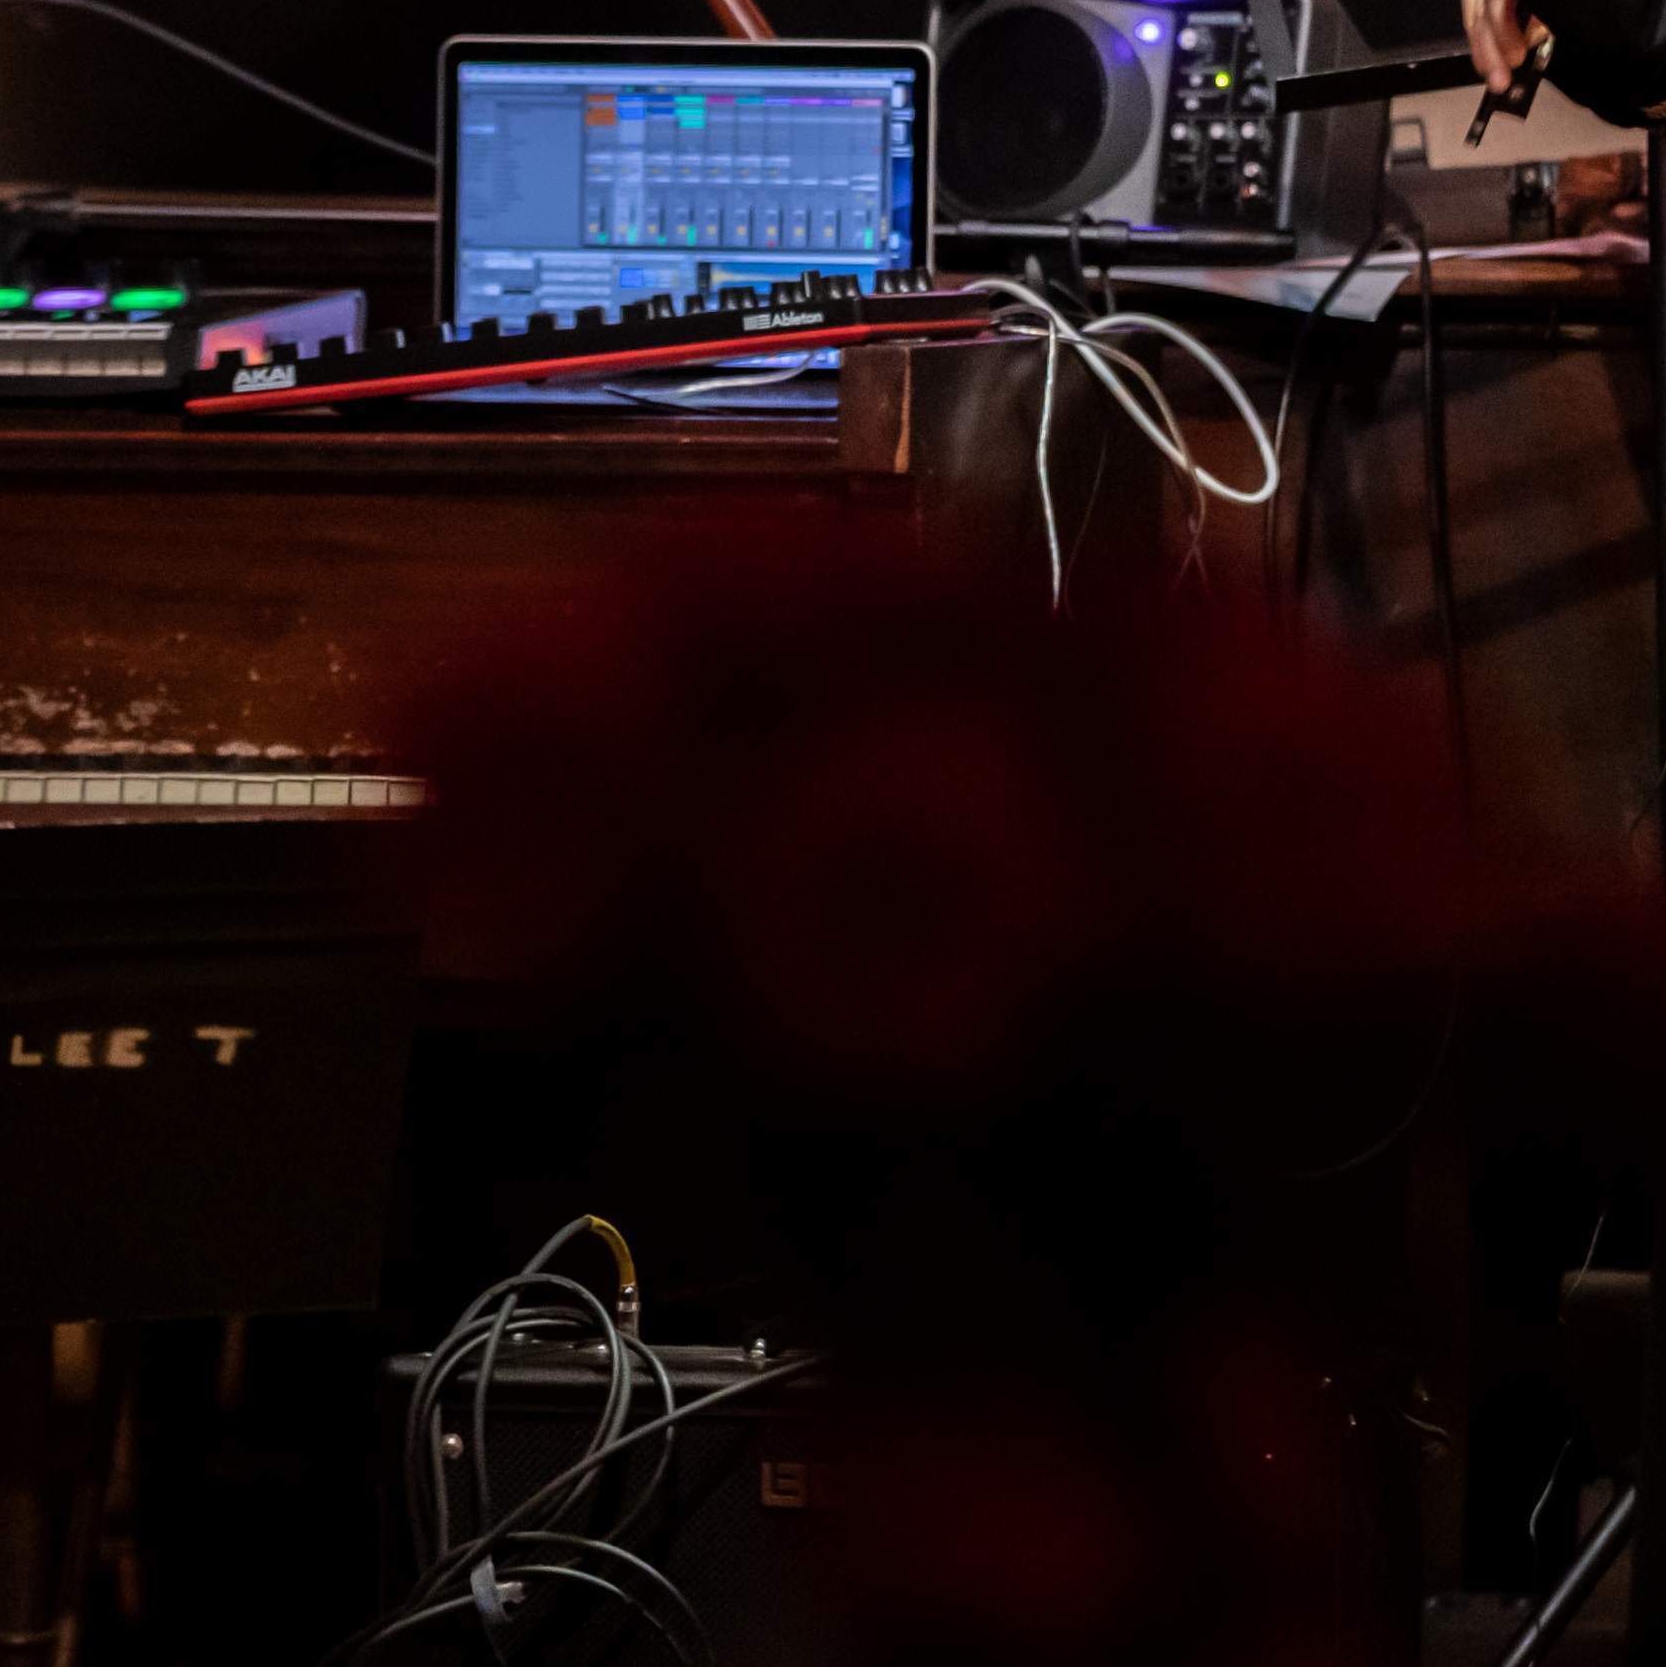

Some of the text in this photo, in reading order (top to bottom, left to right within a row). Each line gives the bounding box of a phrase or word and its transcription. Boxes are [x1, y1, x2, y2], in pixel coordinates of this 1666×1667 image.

[772, 310, 824, 327] Ableton
[232, 364, 296, 393] AKAI
[10, 1028, 150, 1067] LEE
